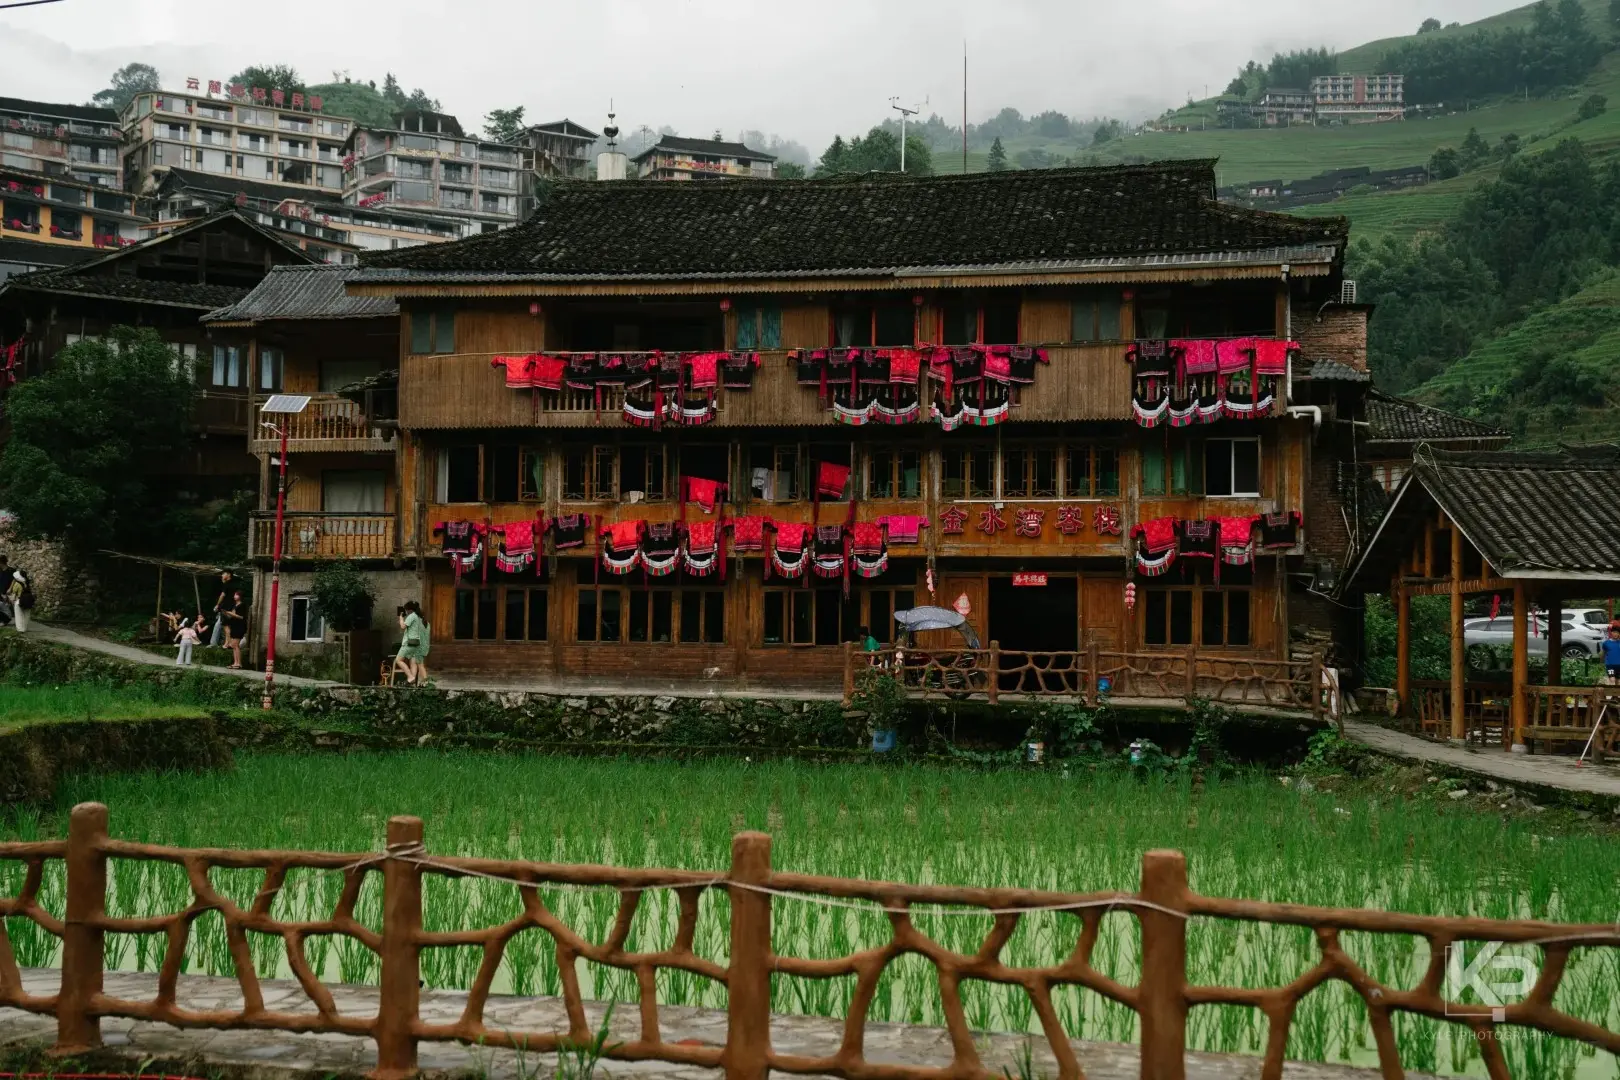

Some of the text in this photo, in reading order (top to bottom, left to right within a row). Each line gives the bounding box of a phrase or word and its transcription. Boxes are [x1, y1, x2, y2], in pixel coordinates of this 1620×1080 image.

[939, 505, 1122, 537] 金水湾客栈
